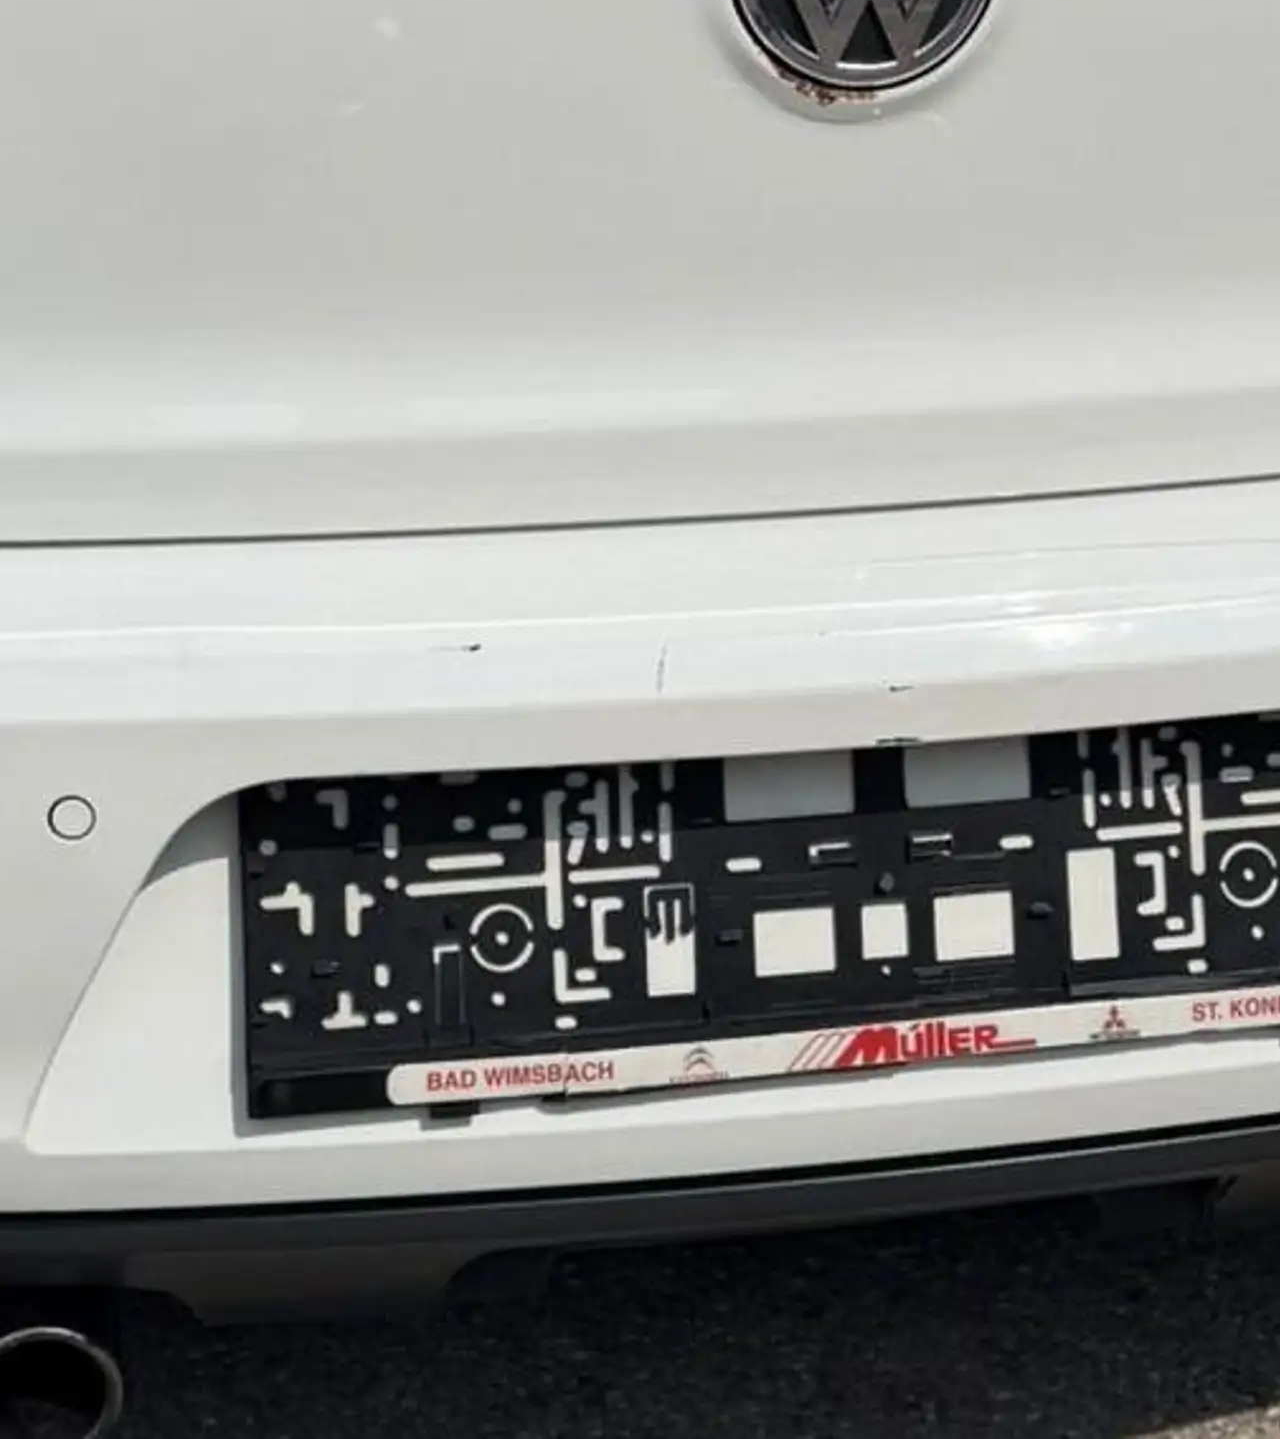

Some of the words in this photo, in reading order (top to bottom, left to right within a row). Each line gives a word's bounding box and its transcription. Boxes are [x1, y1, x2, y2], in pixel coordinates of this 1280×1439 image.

[1191, 1001, 1223, 1023] ST.
[426, 1069, 477, 1093] BAD
[483, 1062, 615, 1086] WIMSBACH
